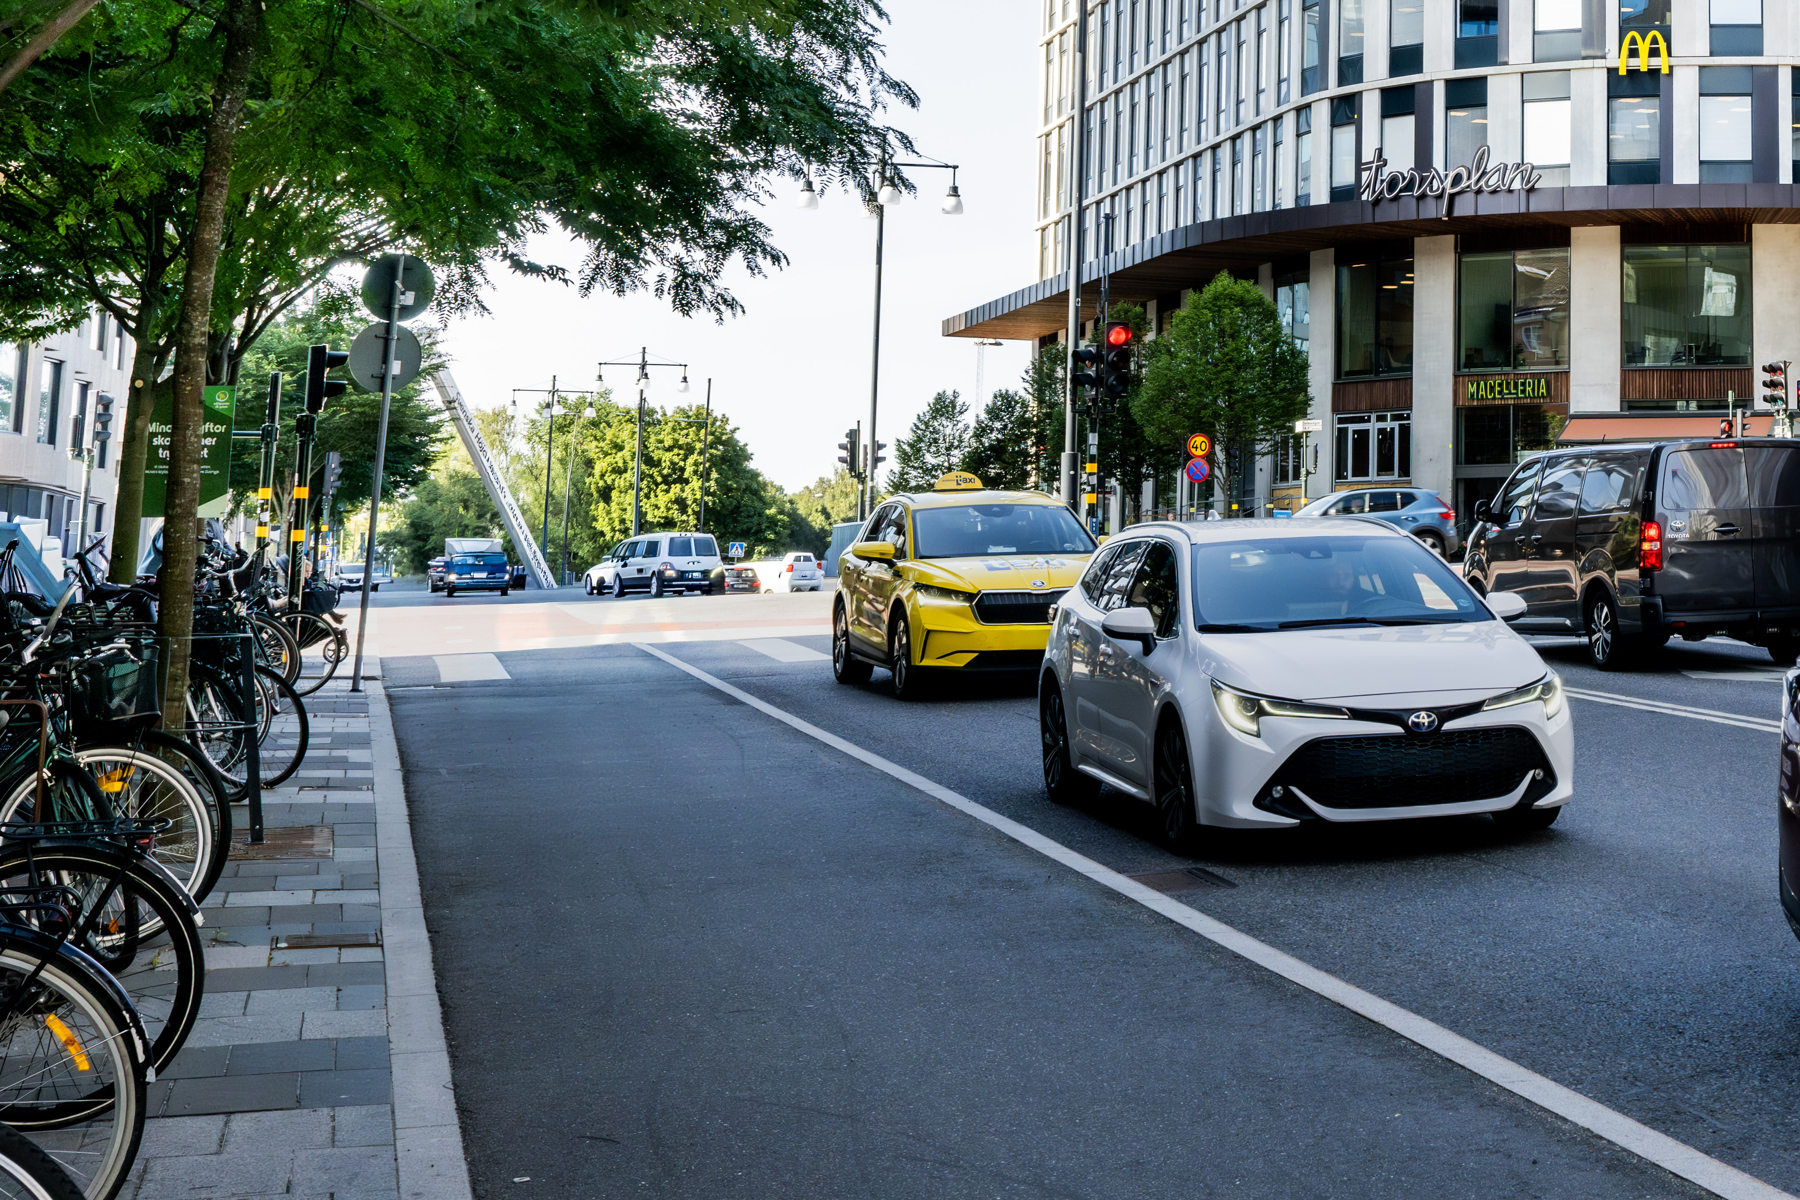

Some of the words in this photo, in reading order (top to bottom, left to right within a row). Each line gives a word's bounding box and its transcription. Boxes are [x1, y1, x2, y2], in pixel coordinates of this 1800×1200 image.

[1360, 145, 1542, 218] torsplan
[1468, 378, 1547, 399] MACELLERIA
[1191, 440, 1207, 452] 40
